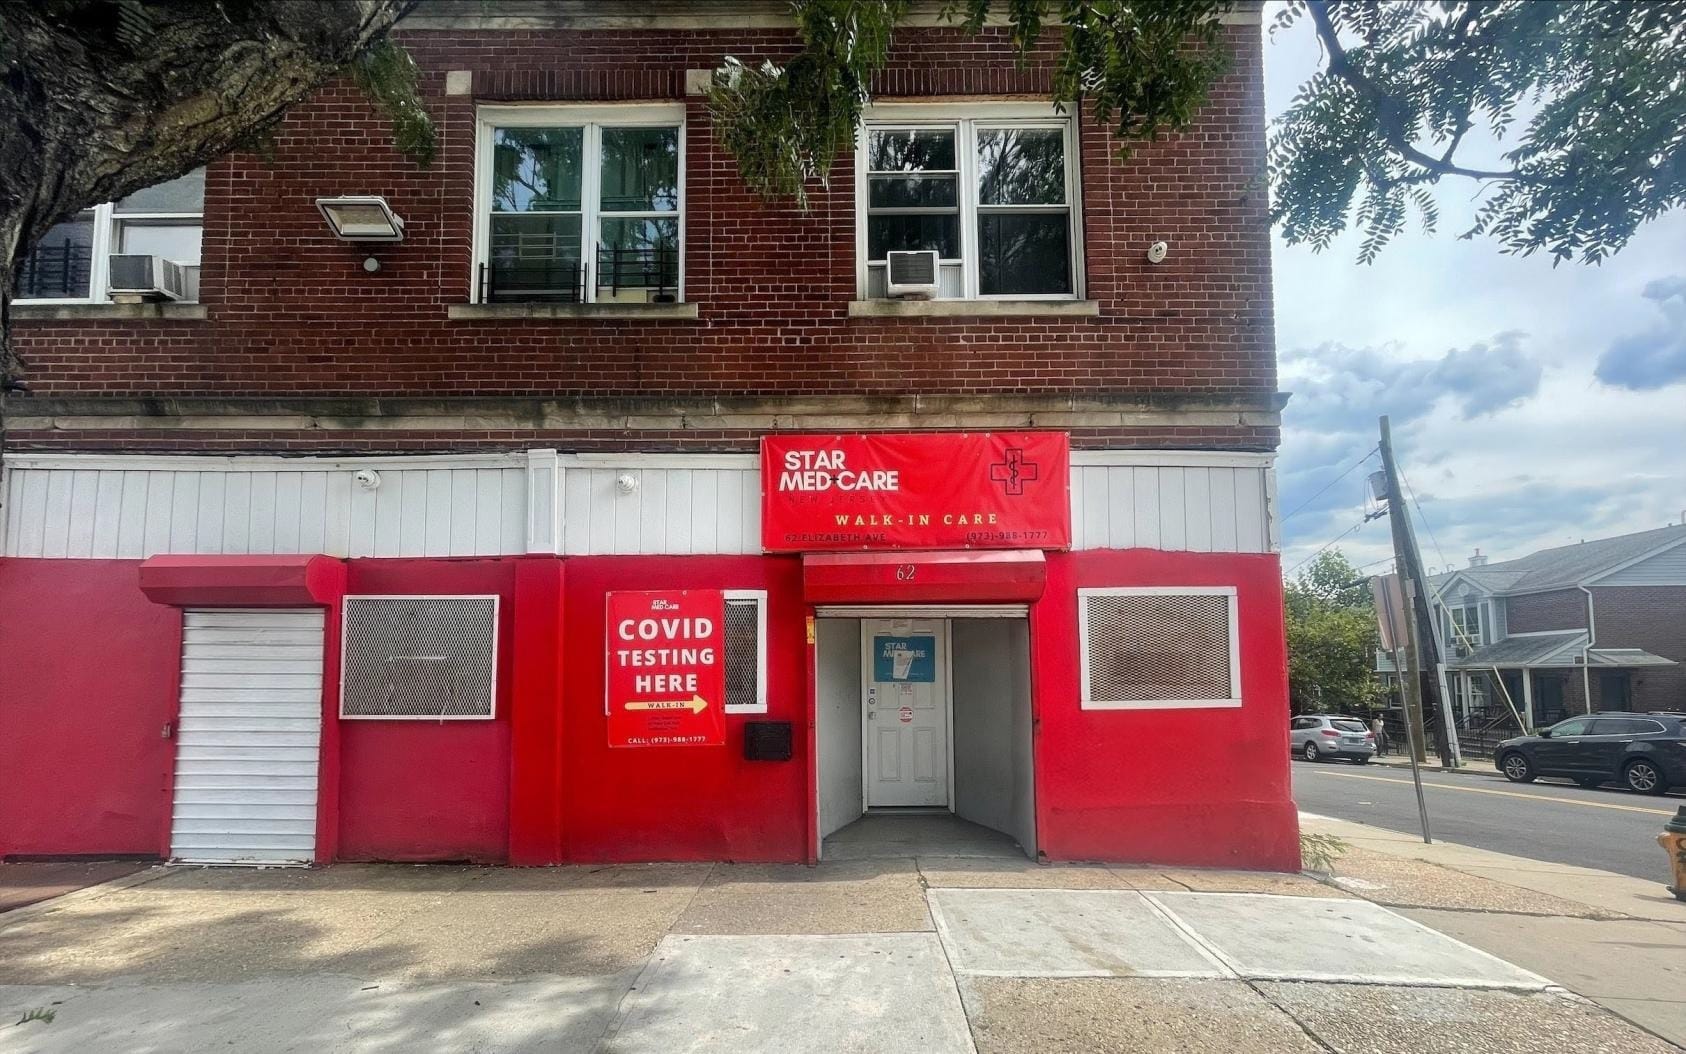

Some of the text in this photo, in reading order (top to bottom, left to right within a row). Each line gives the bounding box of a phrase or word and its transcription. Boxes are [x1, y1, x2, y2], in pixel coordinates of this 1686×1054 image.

[784, 450, 846, 470] STAR
[788, 495, 818, 504] NEW
[835, 513, 997, 526] WALK-IN CARE
[785, 533, 887, 542] 62 ELIZABETH AVE
[896, 564, 915, 580] 62
[618, 617, 713, 641] COVID
[884, 642, 907, 650] STAR
[617, 648, 714, 667] TESTING
[635, 674, 698, 693] HERE
